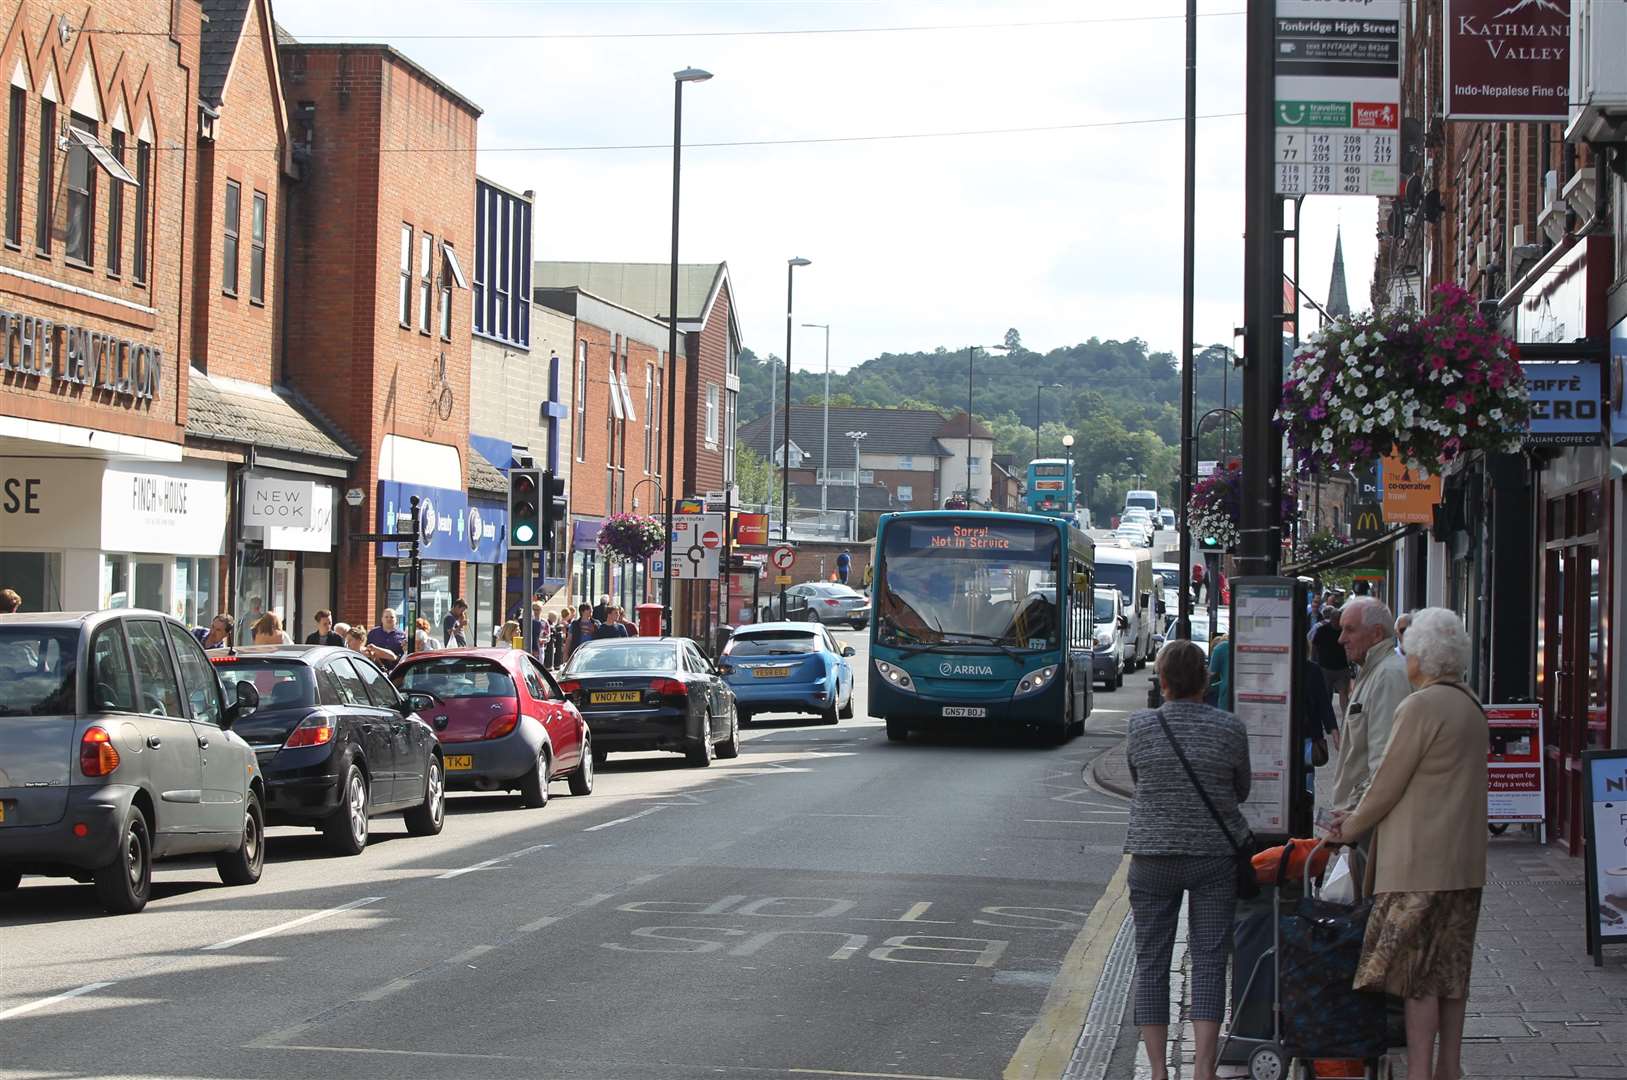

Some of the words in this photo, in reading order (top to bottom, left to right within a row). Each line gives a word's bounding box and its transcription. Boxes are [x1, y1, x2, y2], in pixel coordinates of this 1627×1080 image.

[1278, 21, 1332, 34] Tonbridge
[1335, 22, 1360, 34] High
[1363, 23, 1397, 34] Street
[1486, 40, 1564, 60] VALLEY
[1455, 85, 1529, 98] Indo-Nepalese
[1532, 86, 1553, 96] Fine
[1310, 104, 1346, 112] traveline
[1358, 108, 1378, 118] Kent
[1287, 136, 1294, 146] 7
[1344, 136, 1361, 144] 208
[1344, 145, 1360, 153] 209
[1283, 150, 1298, 160] 77
[62, 324, 162, 401] PAVILION
[1530, 400, 1596, 419] ERO
[1555, 436, 1584, 444] COFFEE
[132, 477, 156, 512] FINCH
[164, 480, 188, 514] HOUSE
[256, 490, 300, 502] NEW
[253, 505, 304, 517] LOOK
[954, 526, 989, 537] Sorry!
[932, 536, 951, 547] Not
[970, 537, 1008, 548] Service
[953, 666, 993, 675] ARRIVA
[594, 693, 617, 702] VN07
[619, 692, 637, 701] VNF
[945, 708, 966, 716] GN57
[448, 756, 471, 768] TKJ
[600, 926, 1008, 967] BUS
